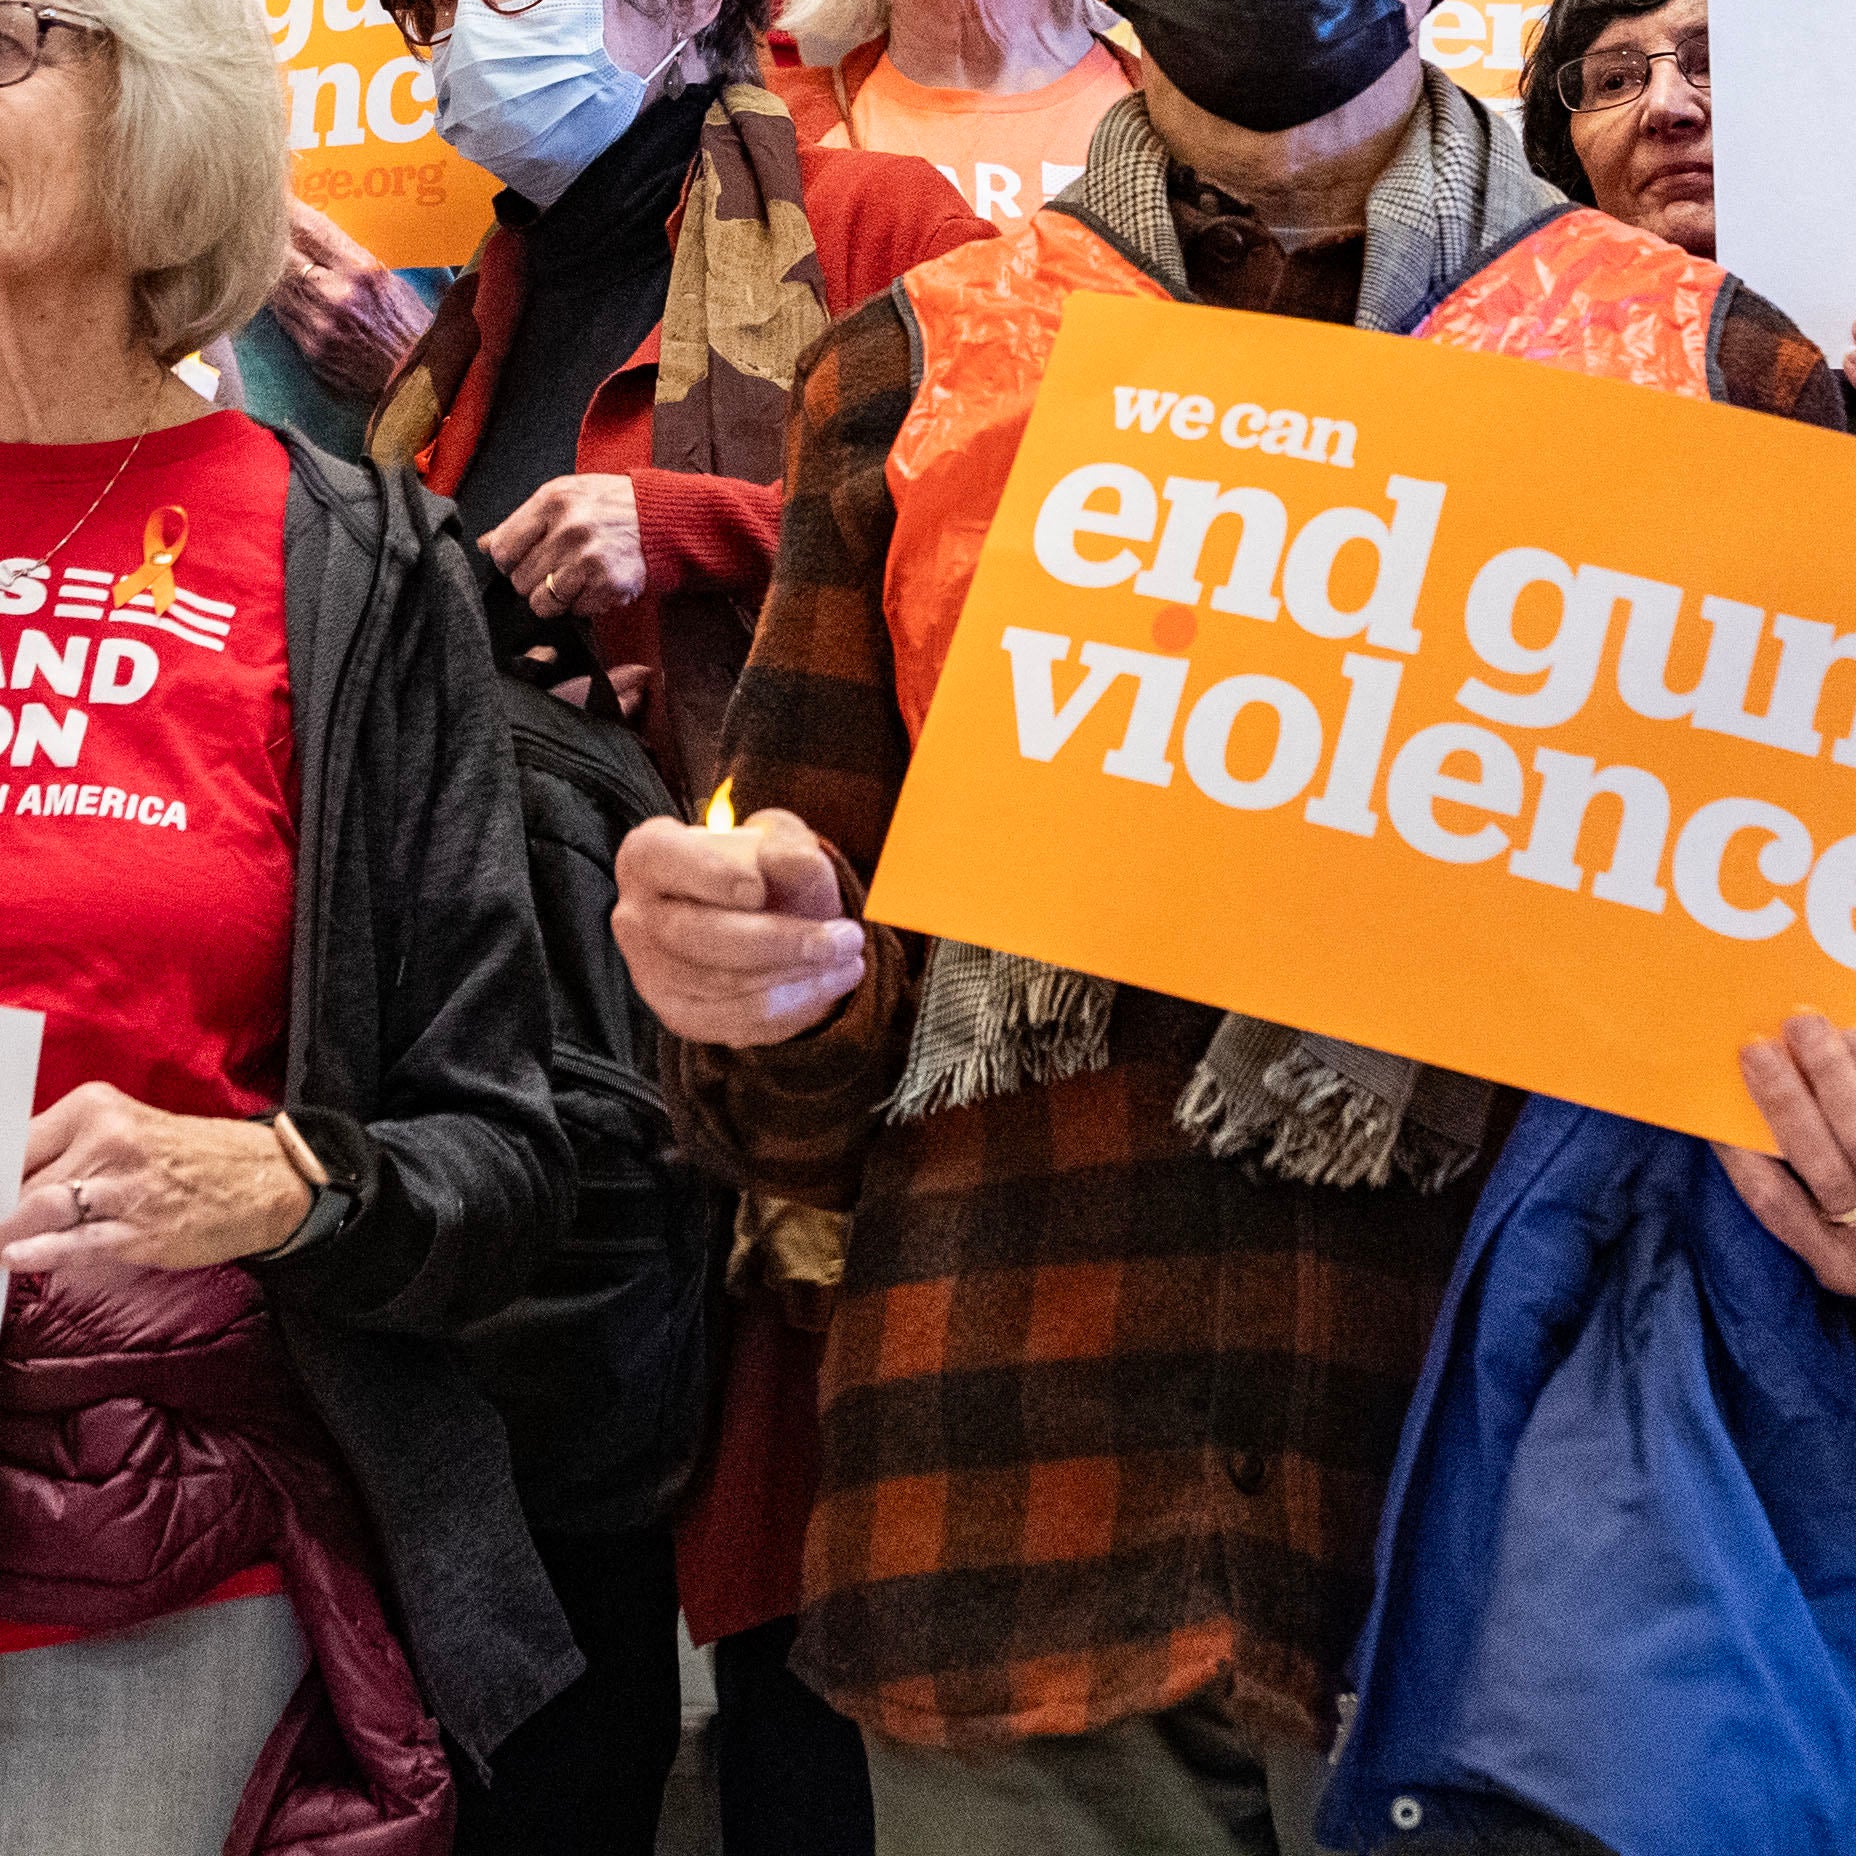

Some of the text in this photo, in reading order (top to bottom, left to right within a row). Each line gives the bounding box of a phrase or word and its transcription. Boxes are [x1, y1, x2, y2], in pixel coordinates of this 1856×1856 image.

[1113, 386, 1358, 469] we can
[1034, 461, 1446, 653] end
[15, 783, 187, 831] AMERICA
